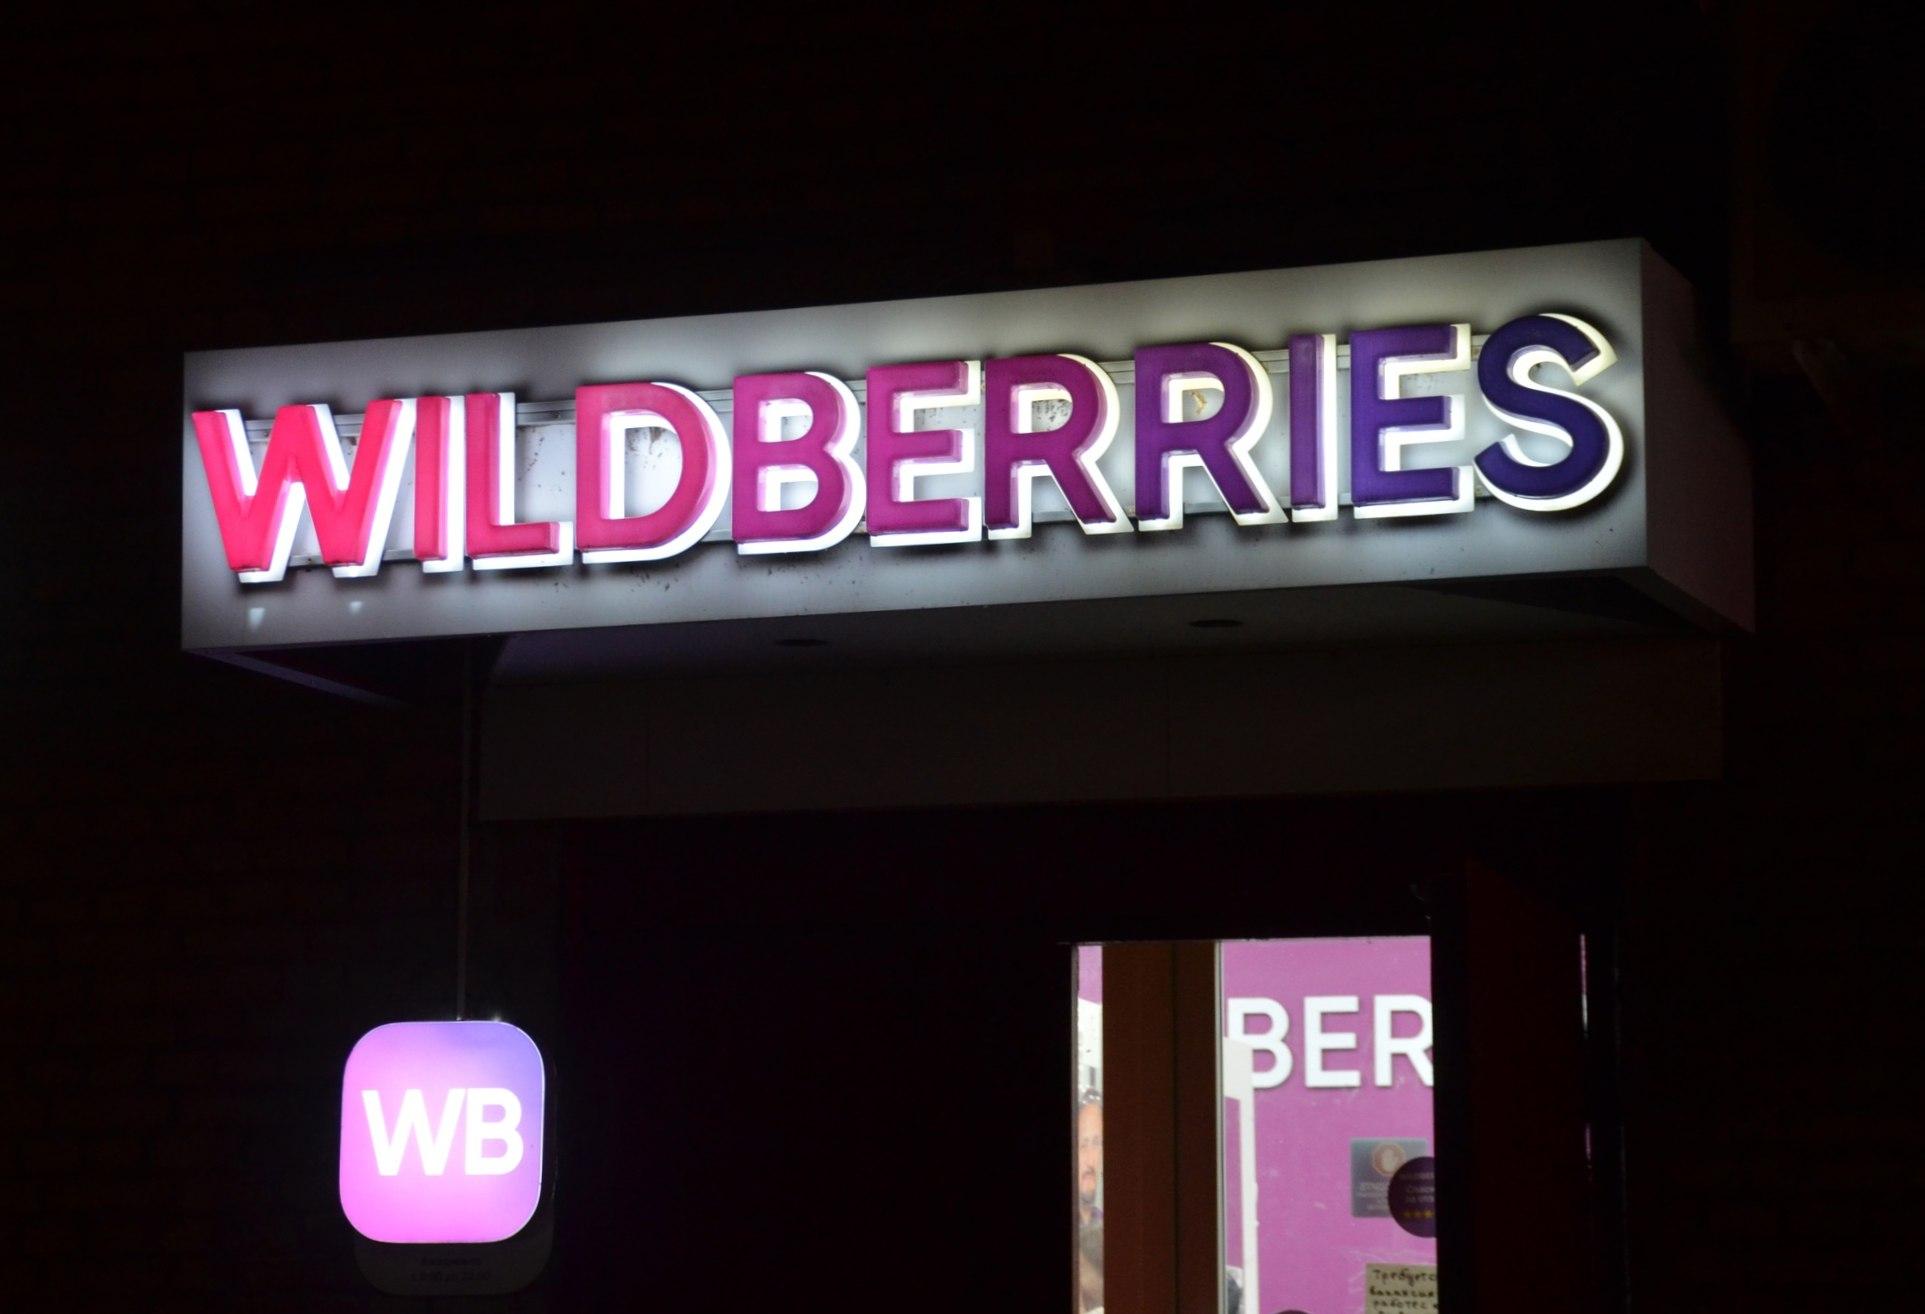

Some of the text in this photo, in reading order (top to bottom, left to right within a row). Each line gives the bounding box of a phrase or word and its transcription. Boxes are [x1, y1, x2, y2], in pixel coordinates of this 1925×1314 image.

[192, 313, 1624, 582] WILDBERRIES
[1227, 995, 1434, 1088] BER
[361, 1088, 524, 1176] WB
